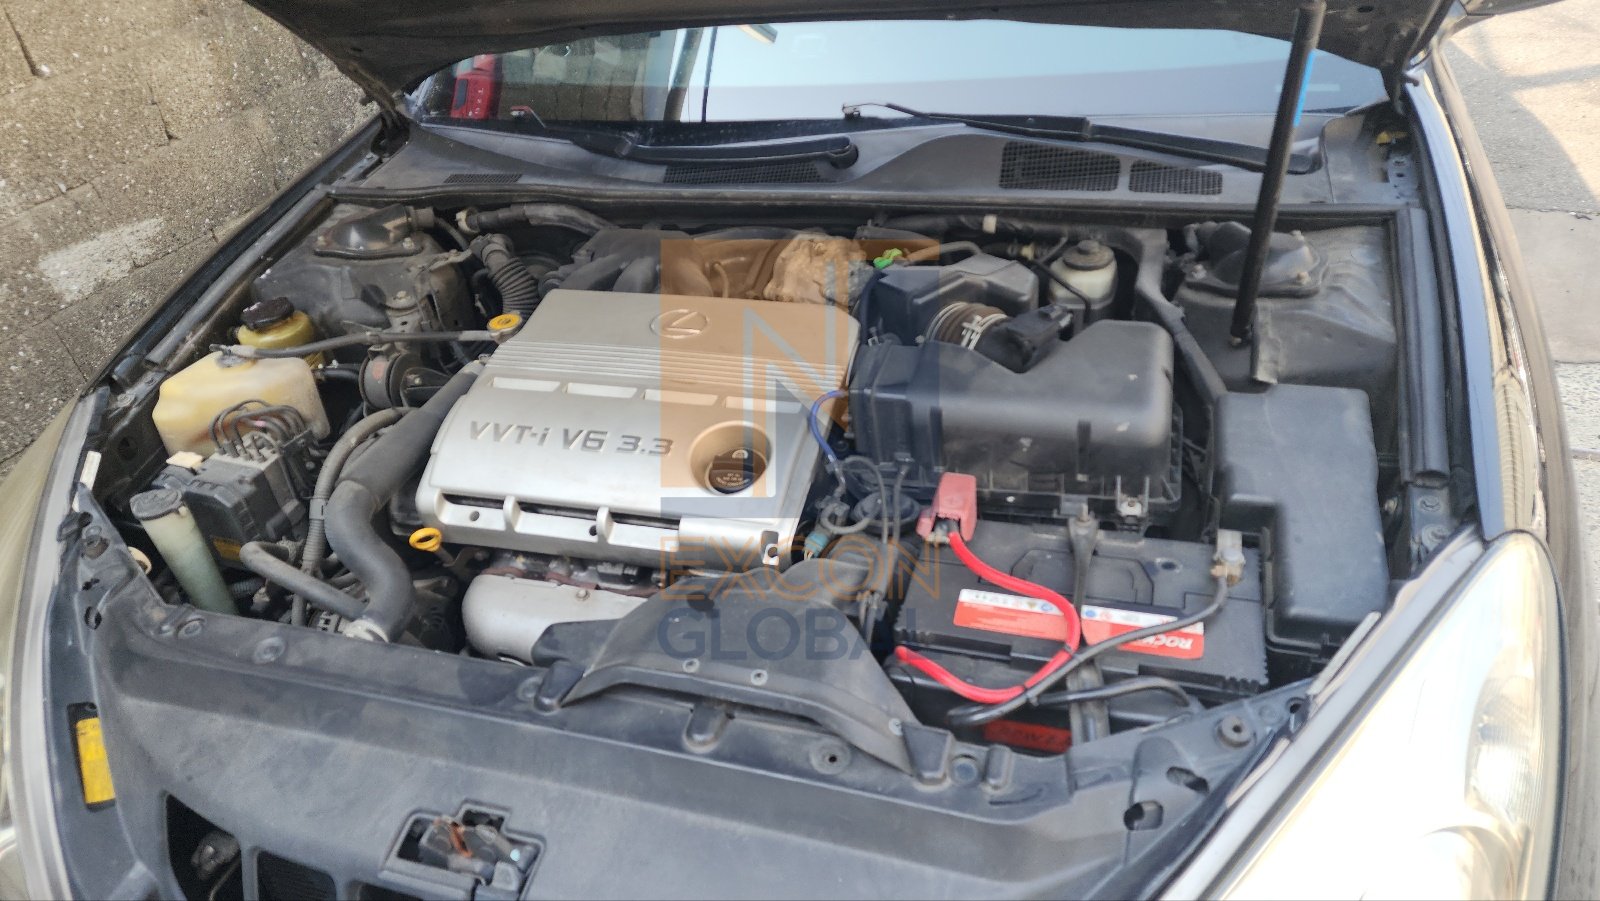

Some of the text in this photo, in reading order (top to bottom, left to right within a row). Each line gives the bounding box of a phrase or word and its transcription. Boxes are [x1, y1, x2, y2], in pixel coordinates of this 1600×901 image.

[469, 420, 674, 457] VVT-i V6 3.3
